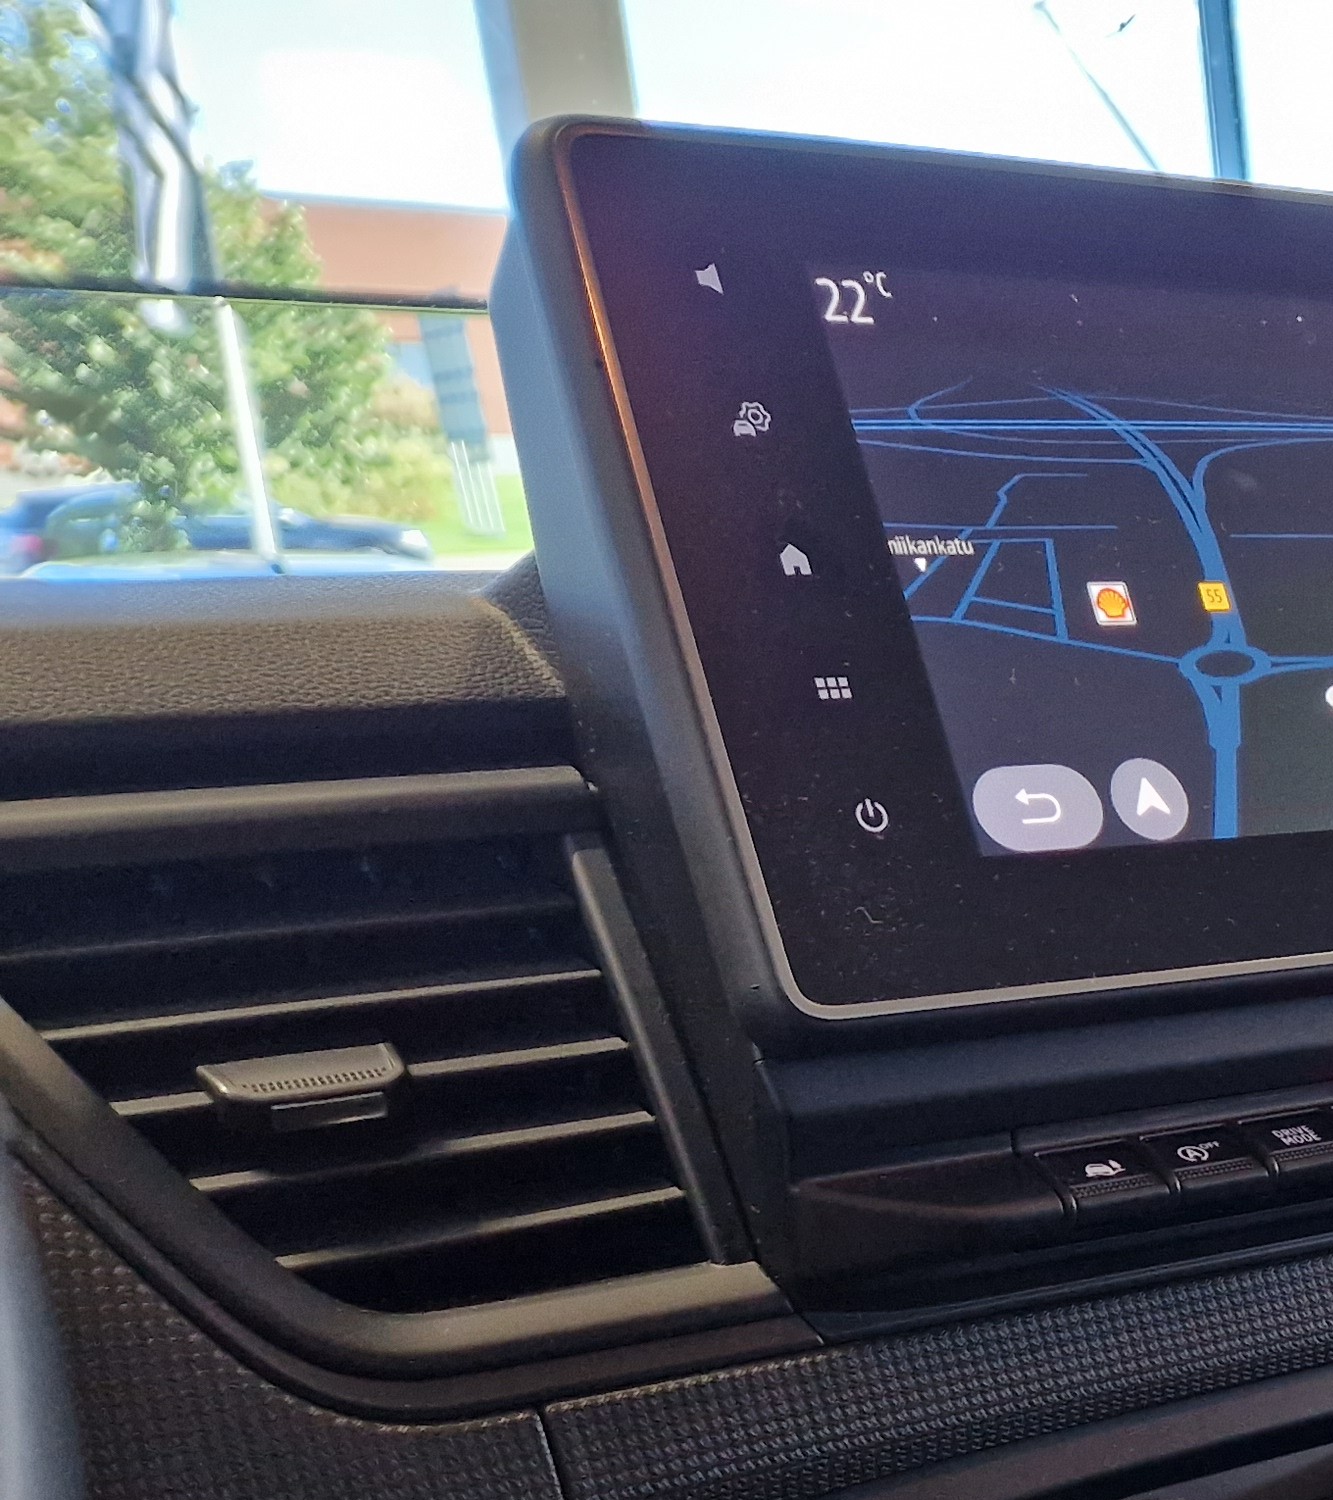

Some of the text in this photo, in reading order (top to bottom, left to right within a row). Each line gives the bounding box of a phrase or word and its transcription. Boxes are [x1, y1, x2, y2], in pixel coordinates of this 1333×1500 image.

[1205, 588, 1223, 604] 55
[1271, 1125, 1315, 1139] DRIVE
[1280, 1133, 1322, 1146] MODE
